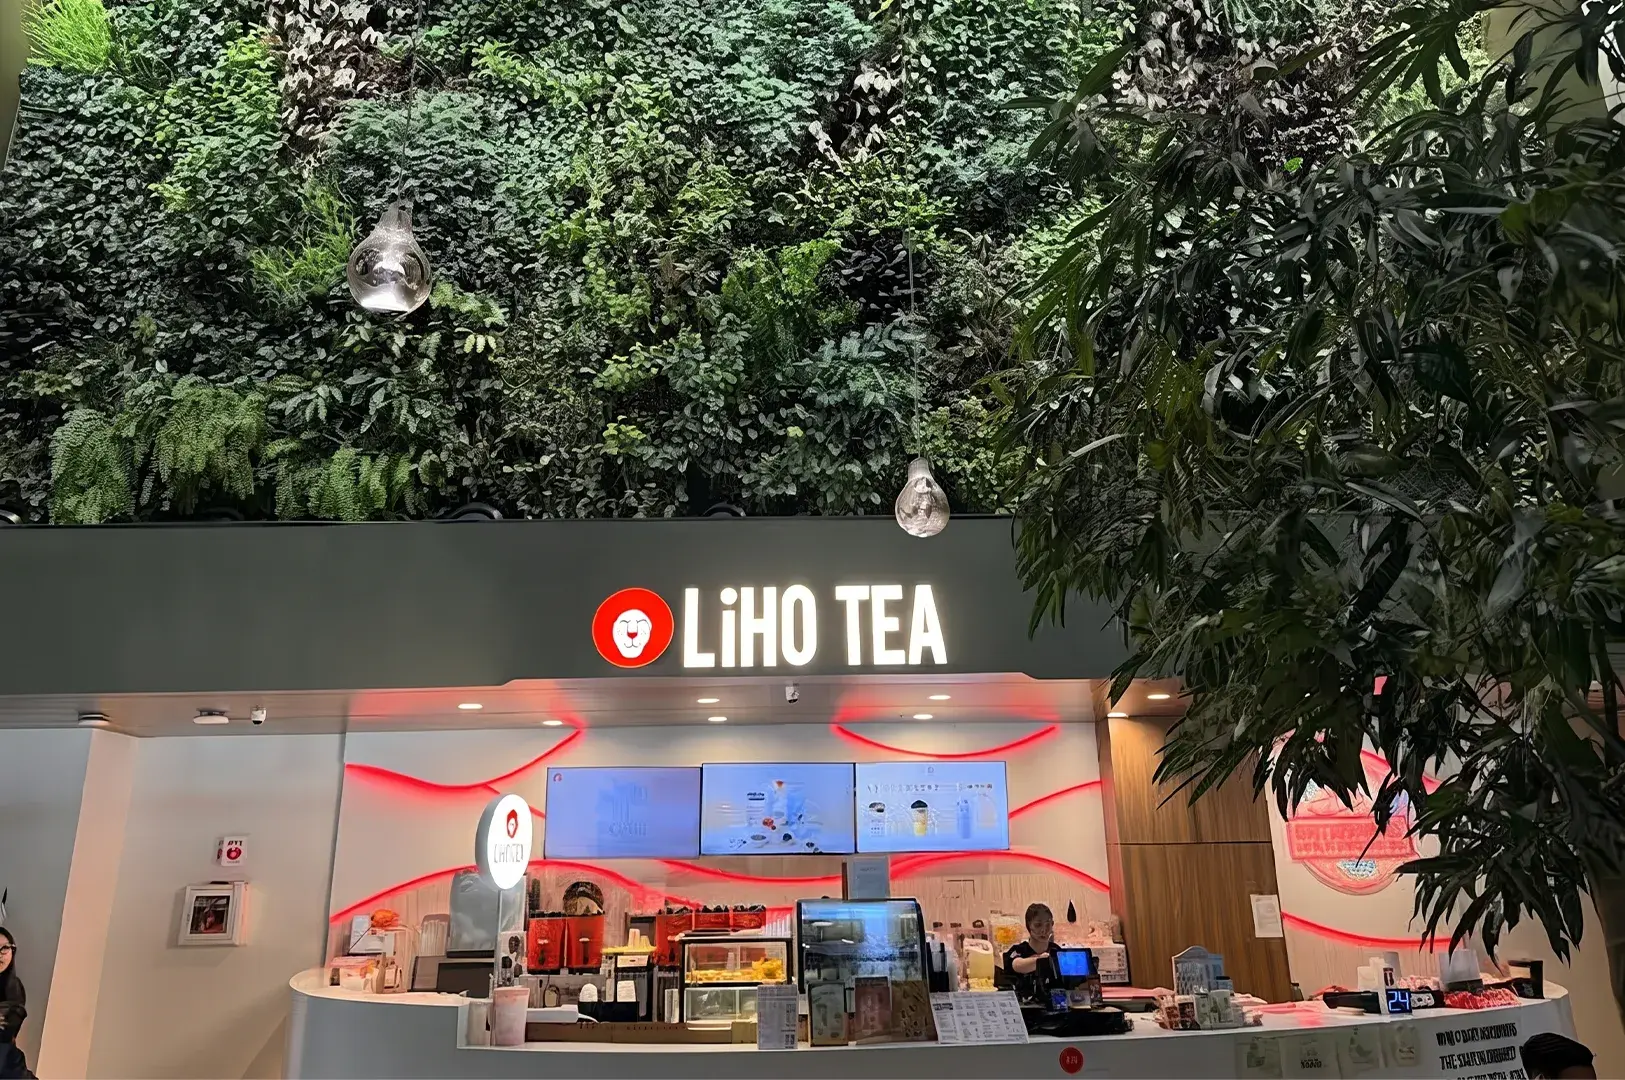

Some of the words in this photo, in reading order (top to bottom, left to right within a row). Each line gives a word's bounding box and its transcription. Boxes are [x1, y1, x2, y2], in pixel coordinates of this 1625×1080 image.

[684, 584, 817, 668] LiHO
[835, 585, 948, 665] TEA
[1388, 991, 1409, 1011] 24
